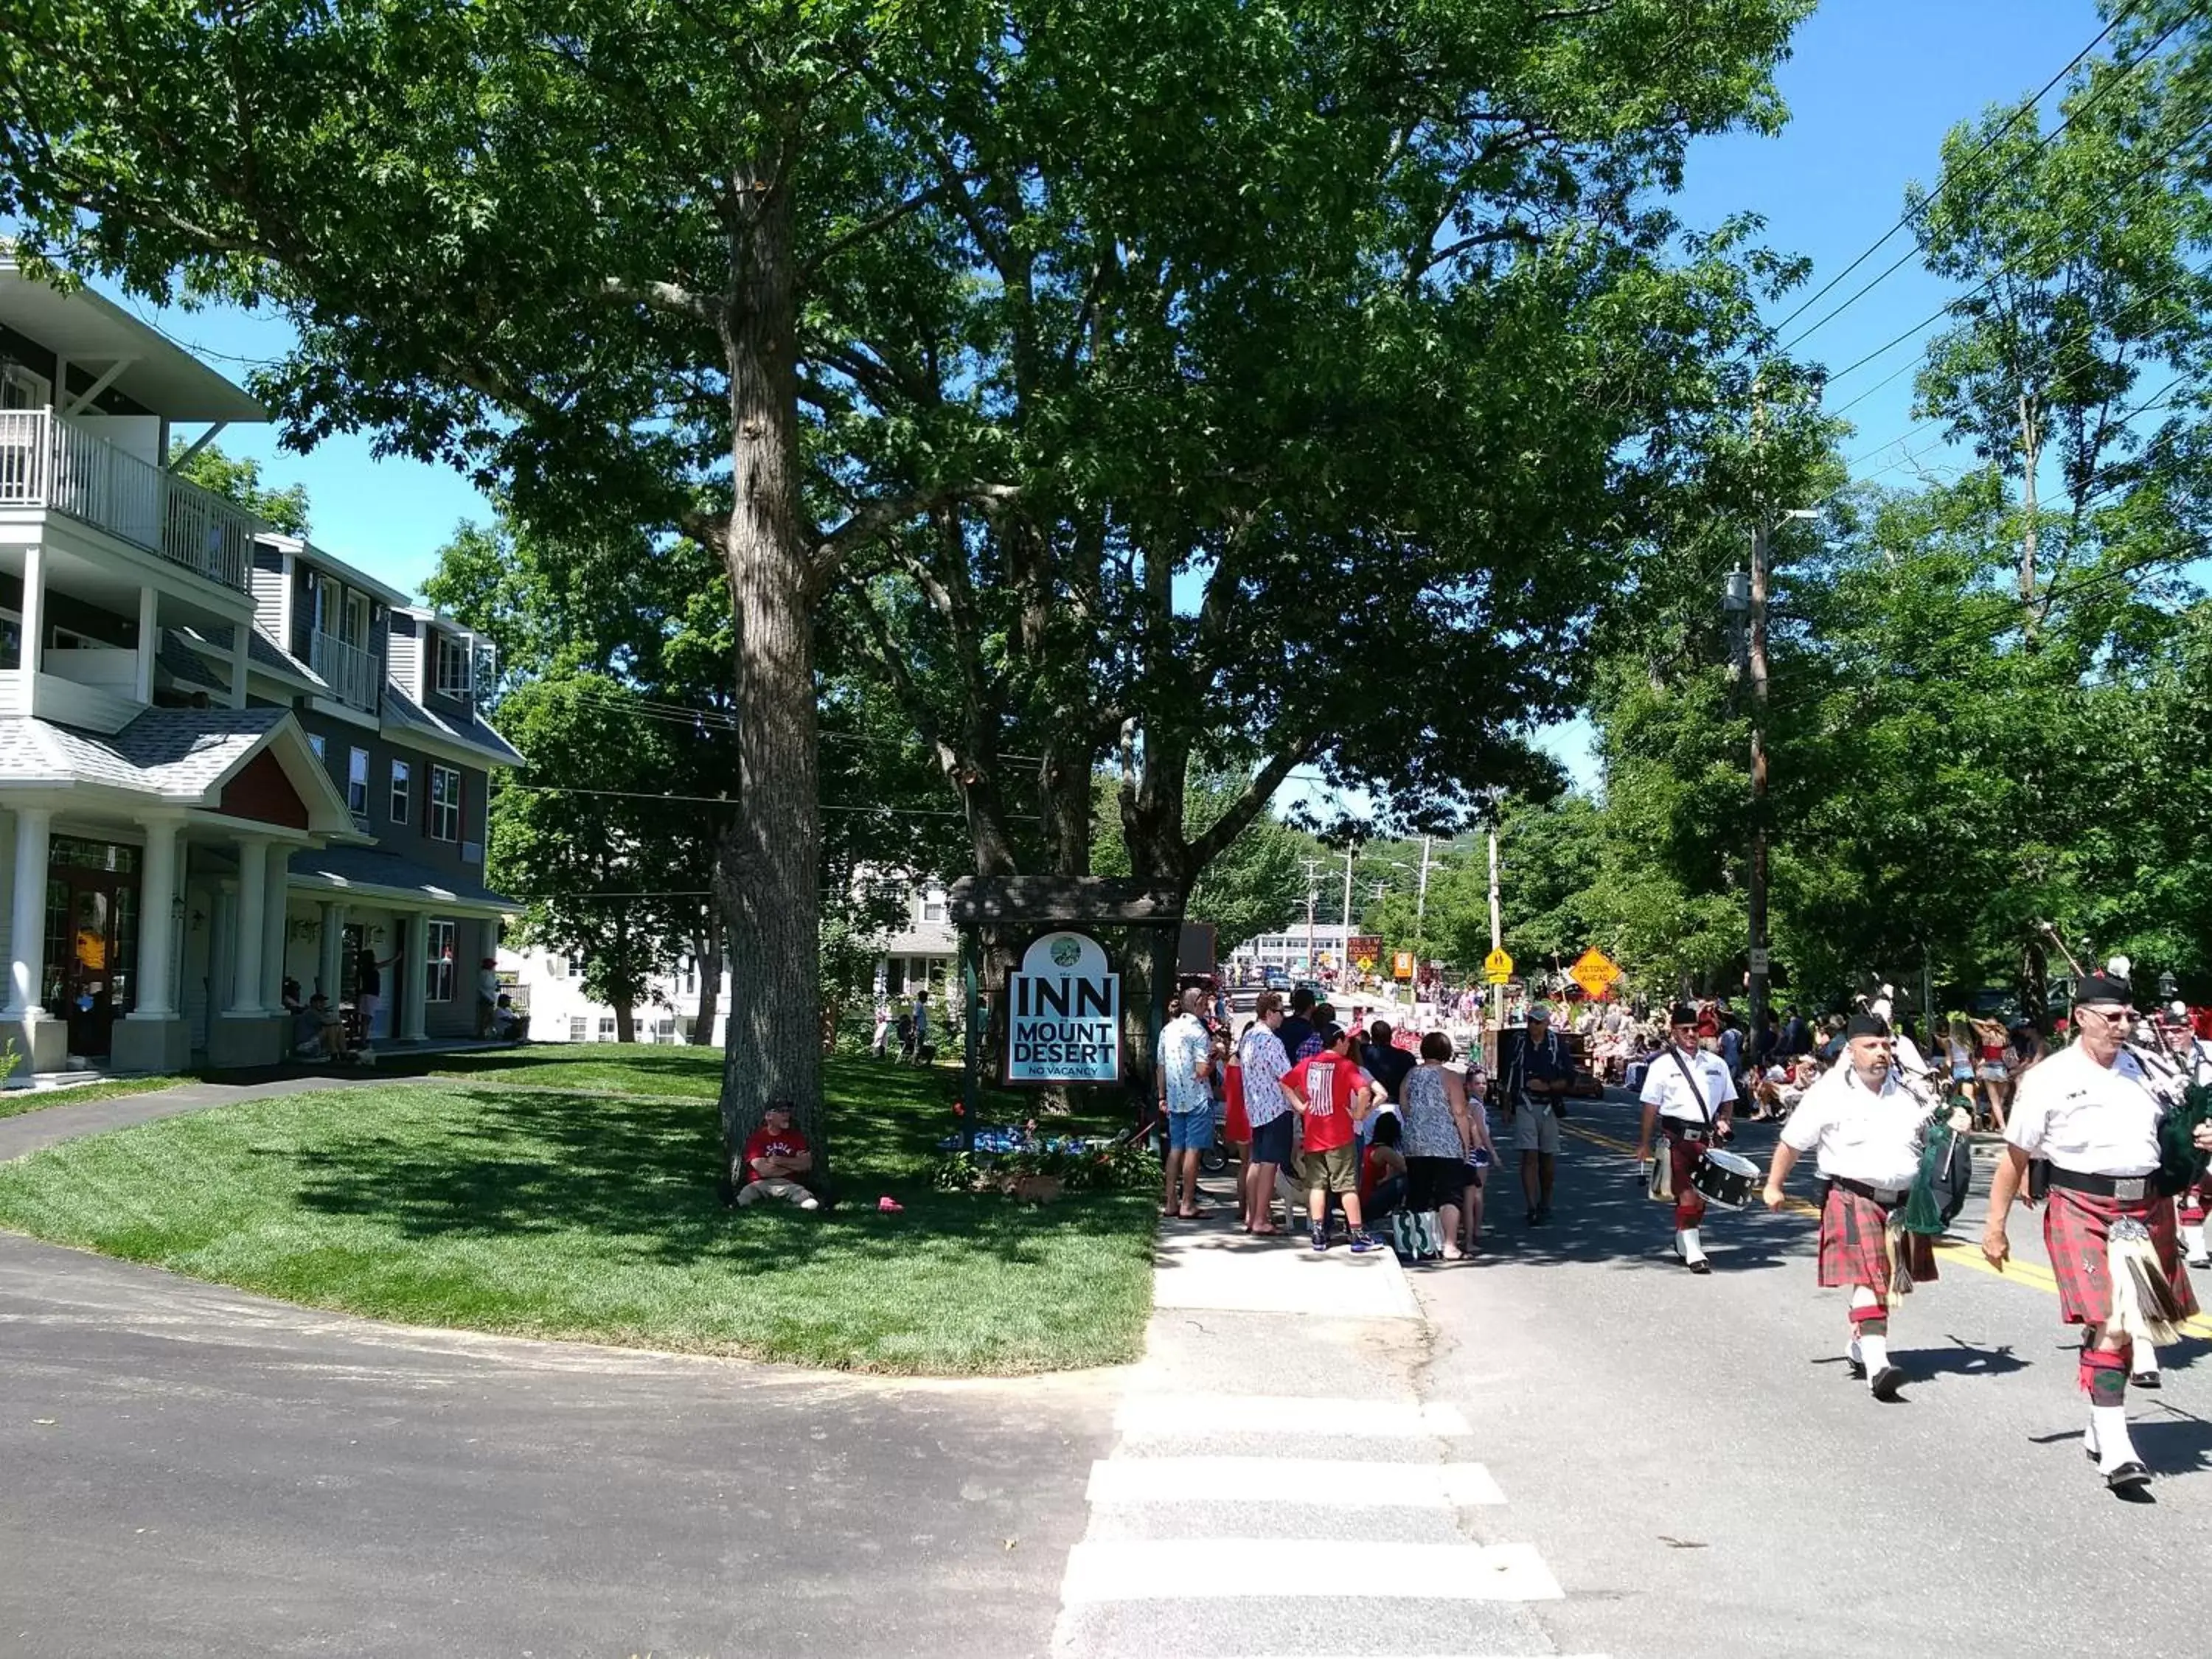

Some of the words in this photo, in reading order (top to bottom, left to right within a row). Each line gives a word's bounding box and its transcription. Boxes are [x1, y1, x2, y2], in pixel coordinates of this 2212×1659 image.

[1582, 974, 1609, 982] AHEAD
[1017, 977, 1113, 1018] INN
[1017, 1023, 1112, 1043] MOUNT
[1014, 1043, 1115, 1063] DESERT
[1029, 1067, 1045, 1075] NO
[1047, 1067, 1098, 1076] VACANCY
